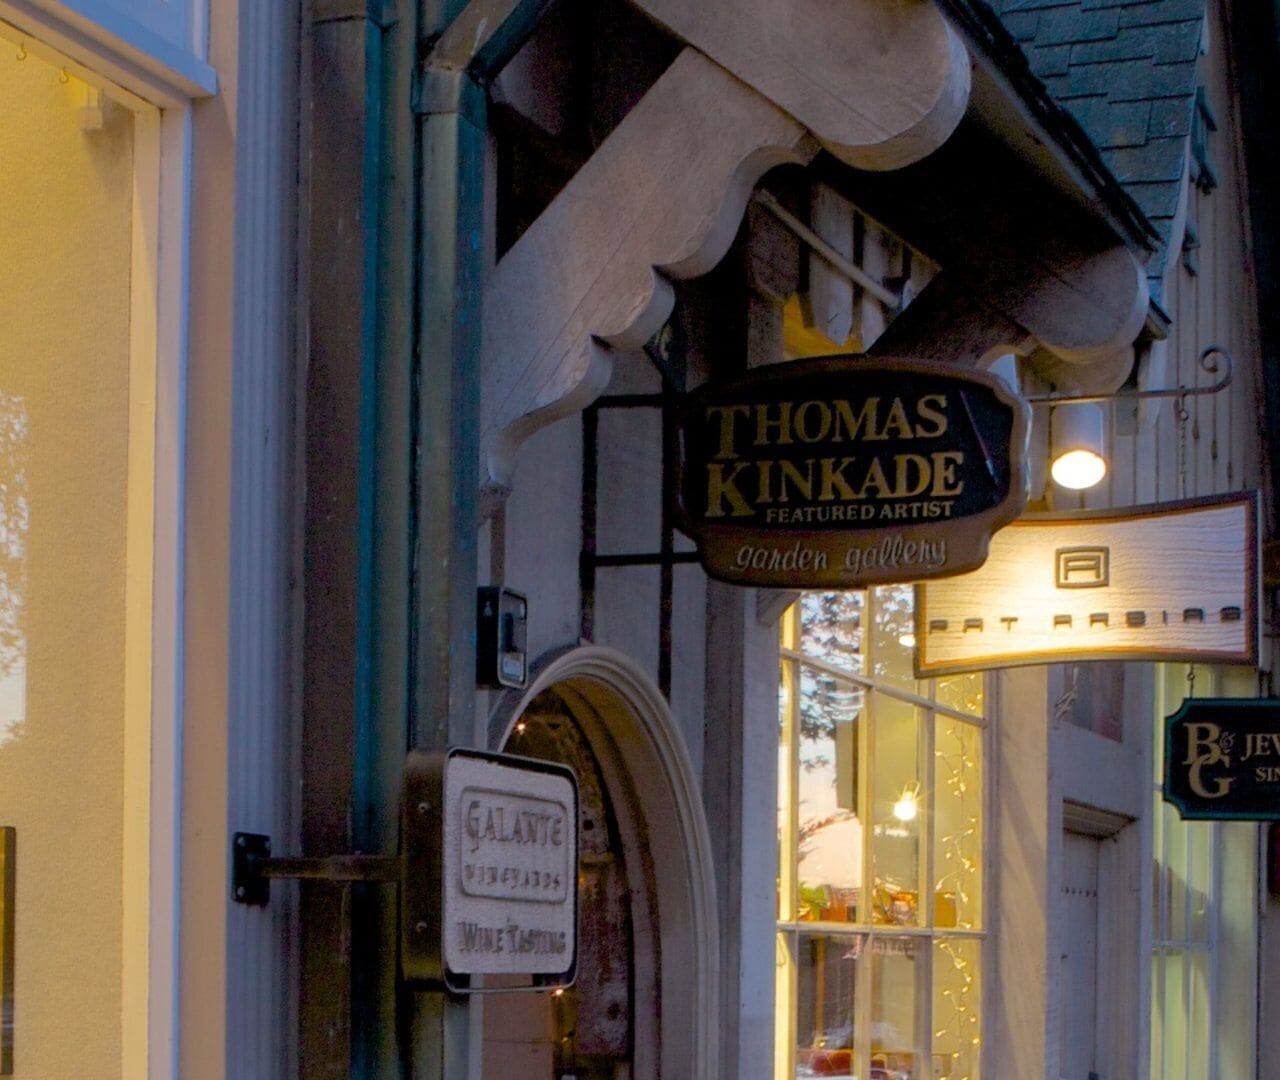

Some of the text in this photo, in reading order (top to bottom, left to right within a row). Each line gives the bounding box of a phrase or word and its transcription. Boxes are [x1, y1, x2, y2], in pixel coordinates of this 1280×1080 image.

[705, 394, 949, 459] THOMAS
[704, 451, 964, 518] KINKADE
[766, 500, 955, 524] FEATURED ARTIST
[729, 534, 947, 577] garden gallery
[465, 799, 563, 853] GALANTE
[457, 920, 567, 954] WINE TASTING
